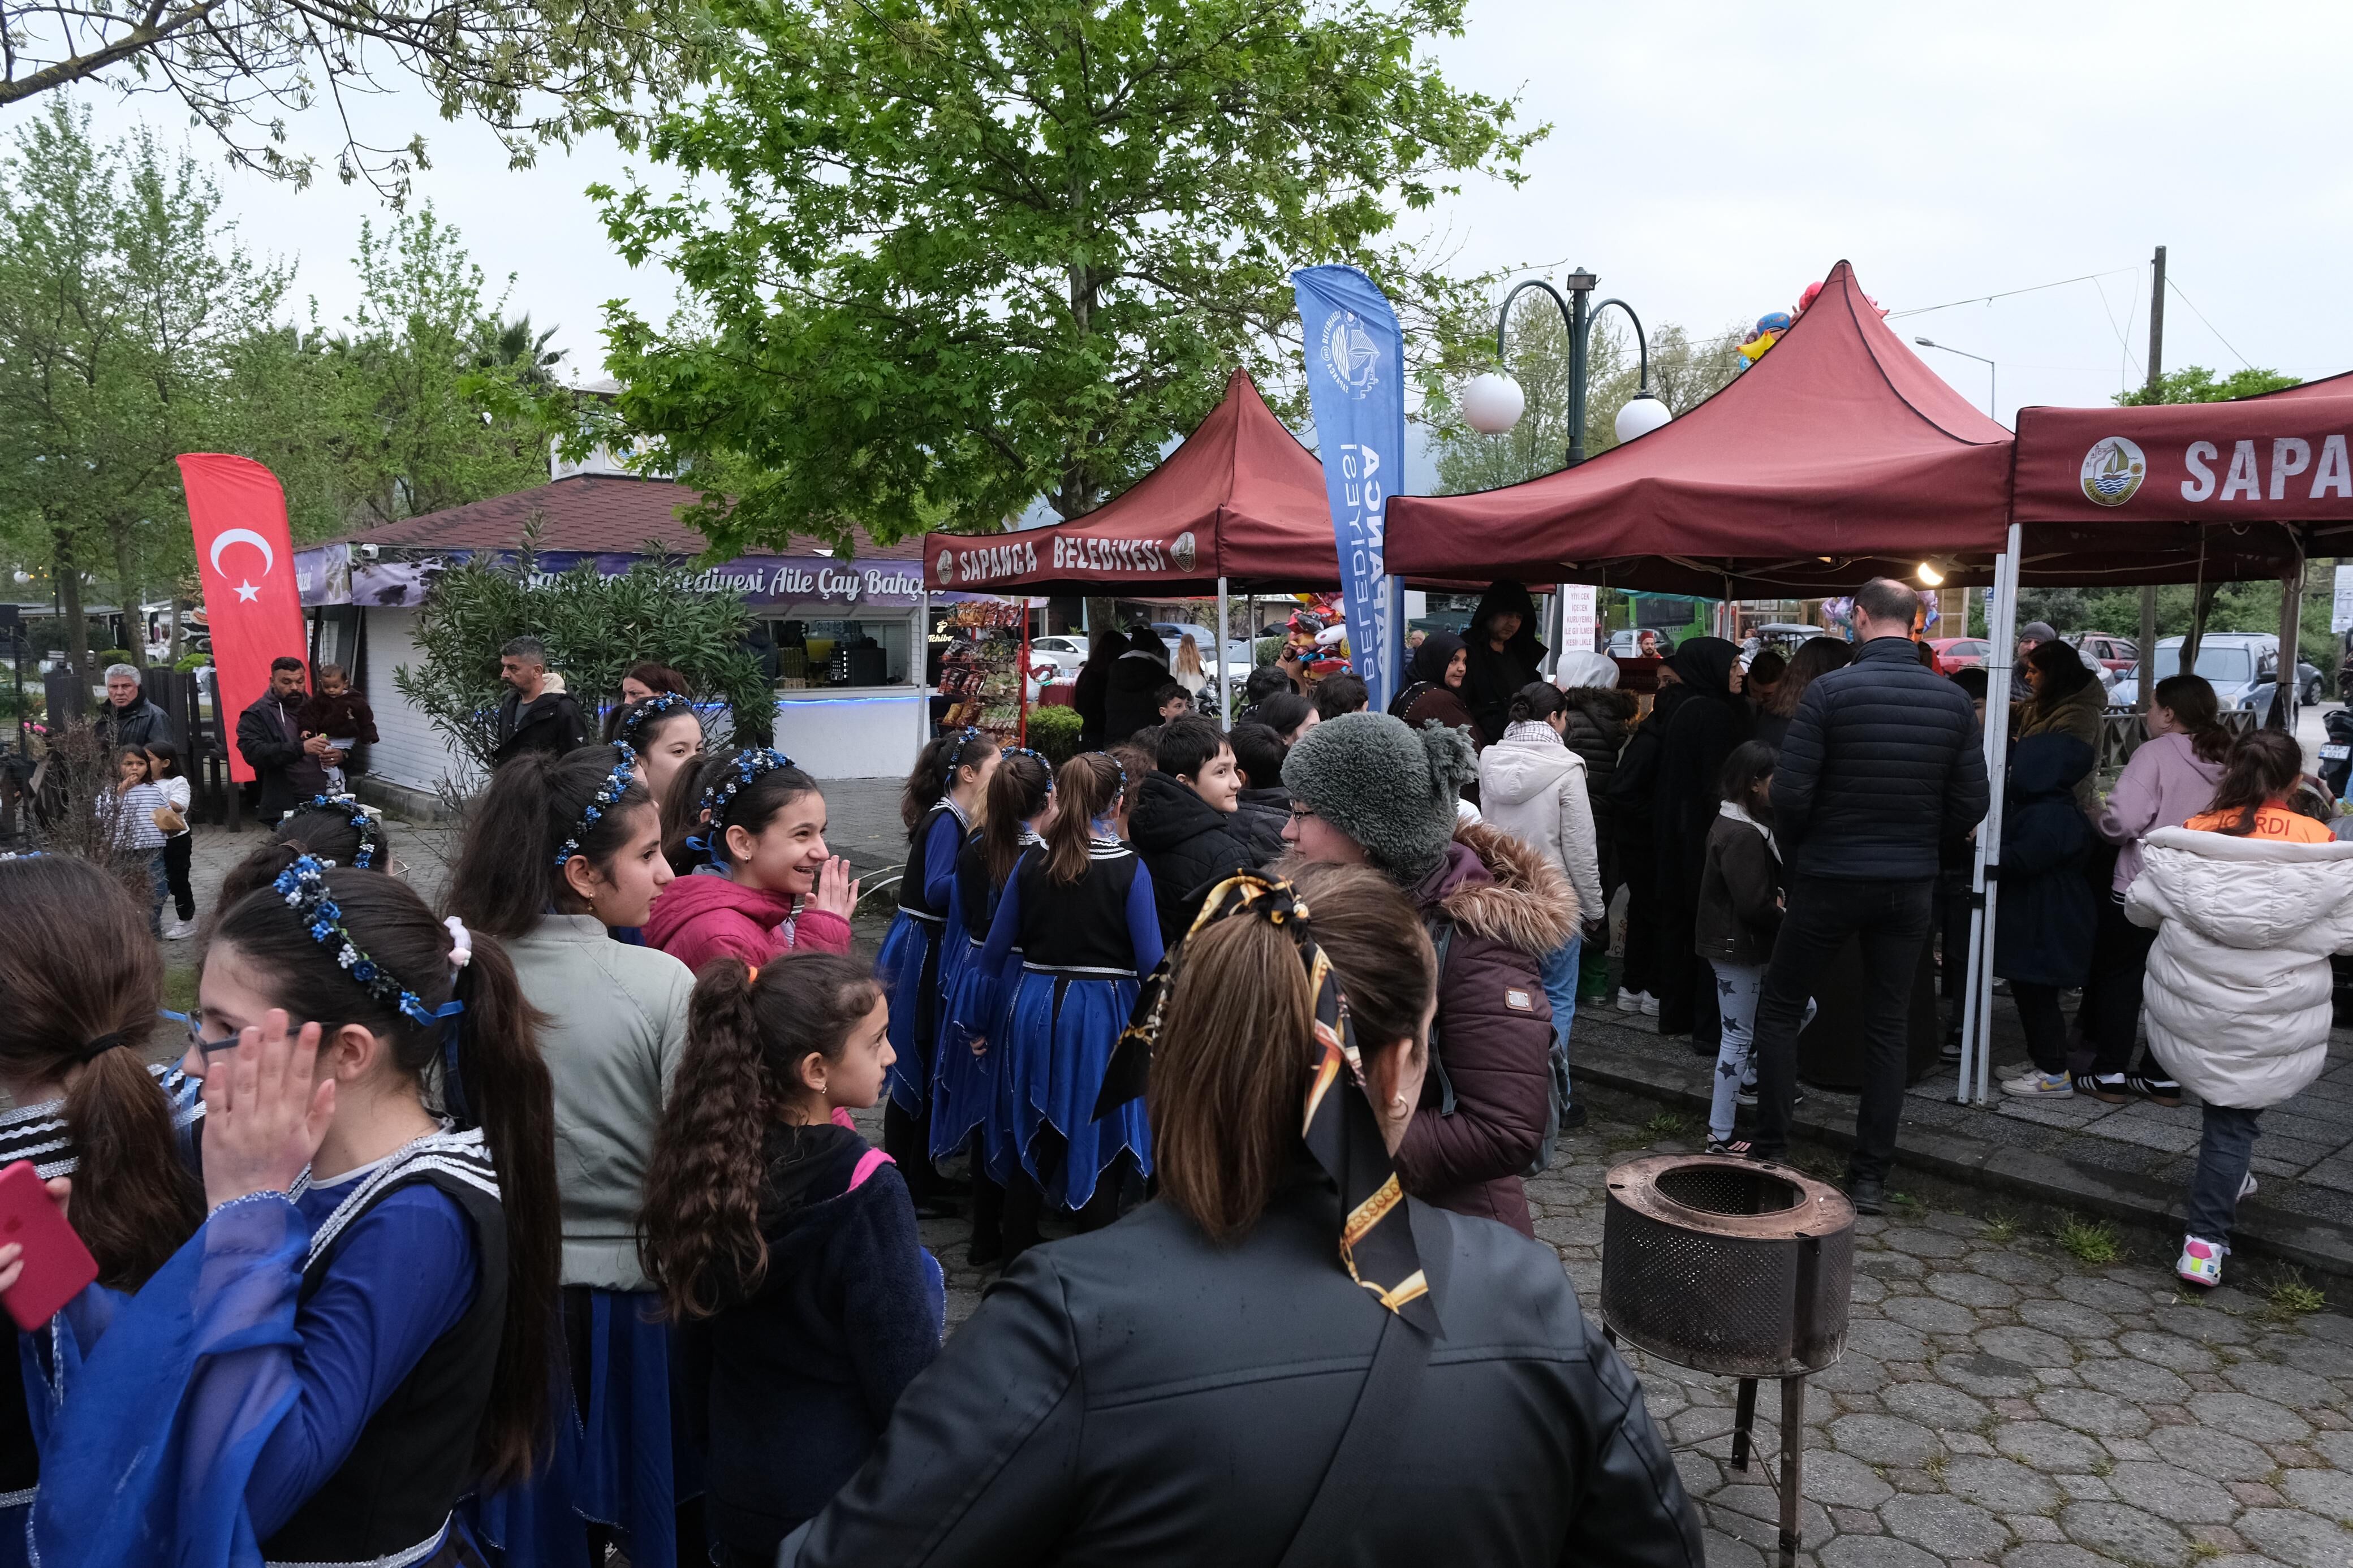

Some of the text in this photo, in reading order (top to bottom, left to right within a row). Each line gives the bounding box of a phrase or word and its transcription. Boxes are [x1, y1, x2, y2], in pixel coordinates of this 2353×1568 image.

[2180, 434, 2353, 502] SAPA
[960, 535, 1167, 582] SAPANCA BELEDİYESİ
[770, 567, 814, 596] Aile
[818, 567, 863, 601] Çay
[864, 569, 946, 602] Bahçe
[928, 634, 954, 643] Tchibo
